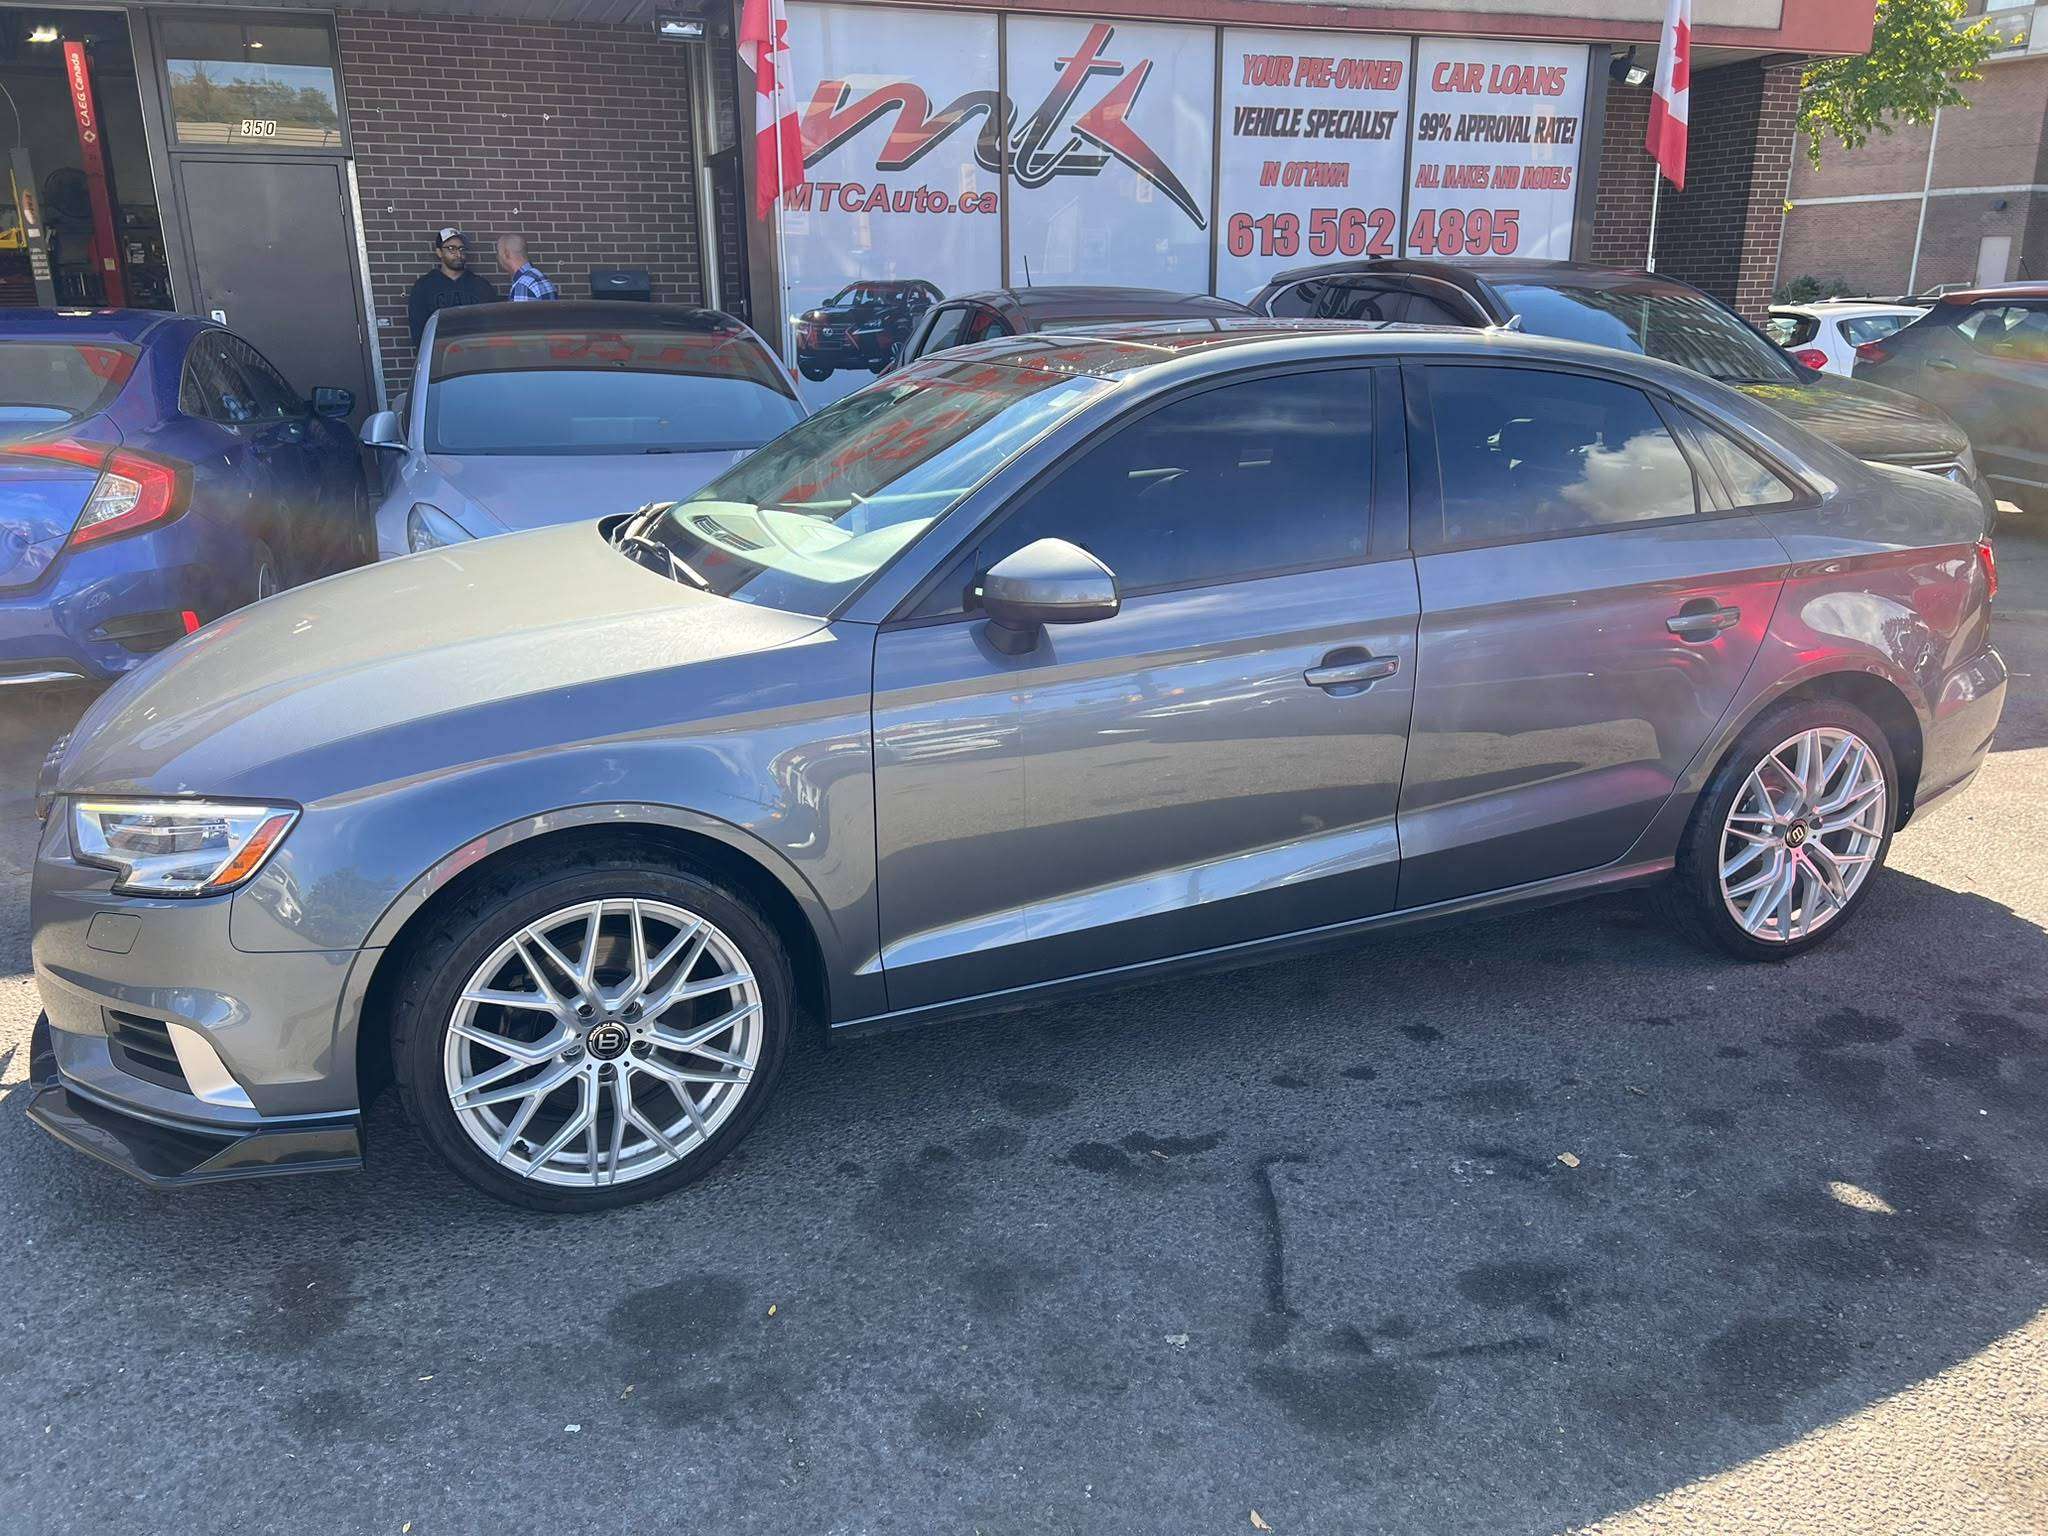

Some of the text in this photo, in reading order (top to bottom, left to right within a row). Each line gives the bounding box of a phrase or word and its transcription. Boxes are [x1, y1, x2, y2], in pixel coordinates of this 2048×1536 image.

[71, 52, 84, 90] Canada
[1242, 53, 1404, 91] YOUR PRE-OWNED
[1431, 61, 1568, 97] CAR LOANS
[243, 120, 275, 136] 350
[1232, 106, 1399, 141] VEHICLE SPECIALIST
[1417, 112, 1578, 145] 99% APPROVAL RATE!
[1260, 160, 1350, 188] IN OTTAWA
[1415, 164, 1573, 191] ALL MAKES AND MODELS
[1227, 207, 1521, 257] 613 562 4895
